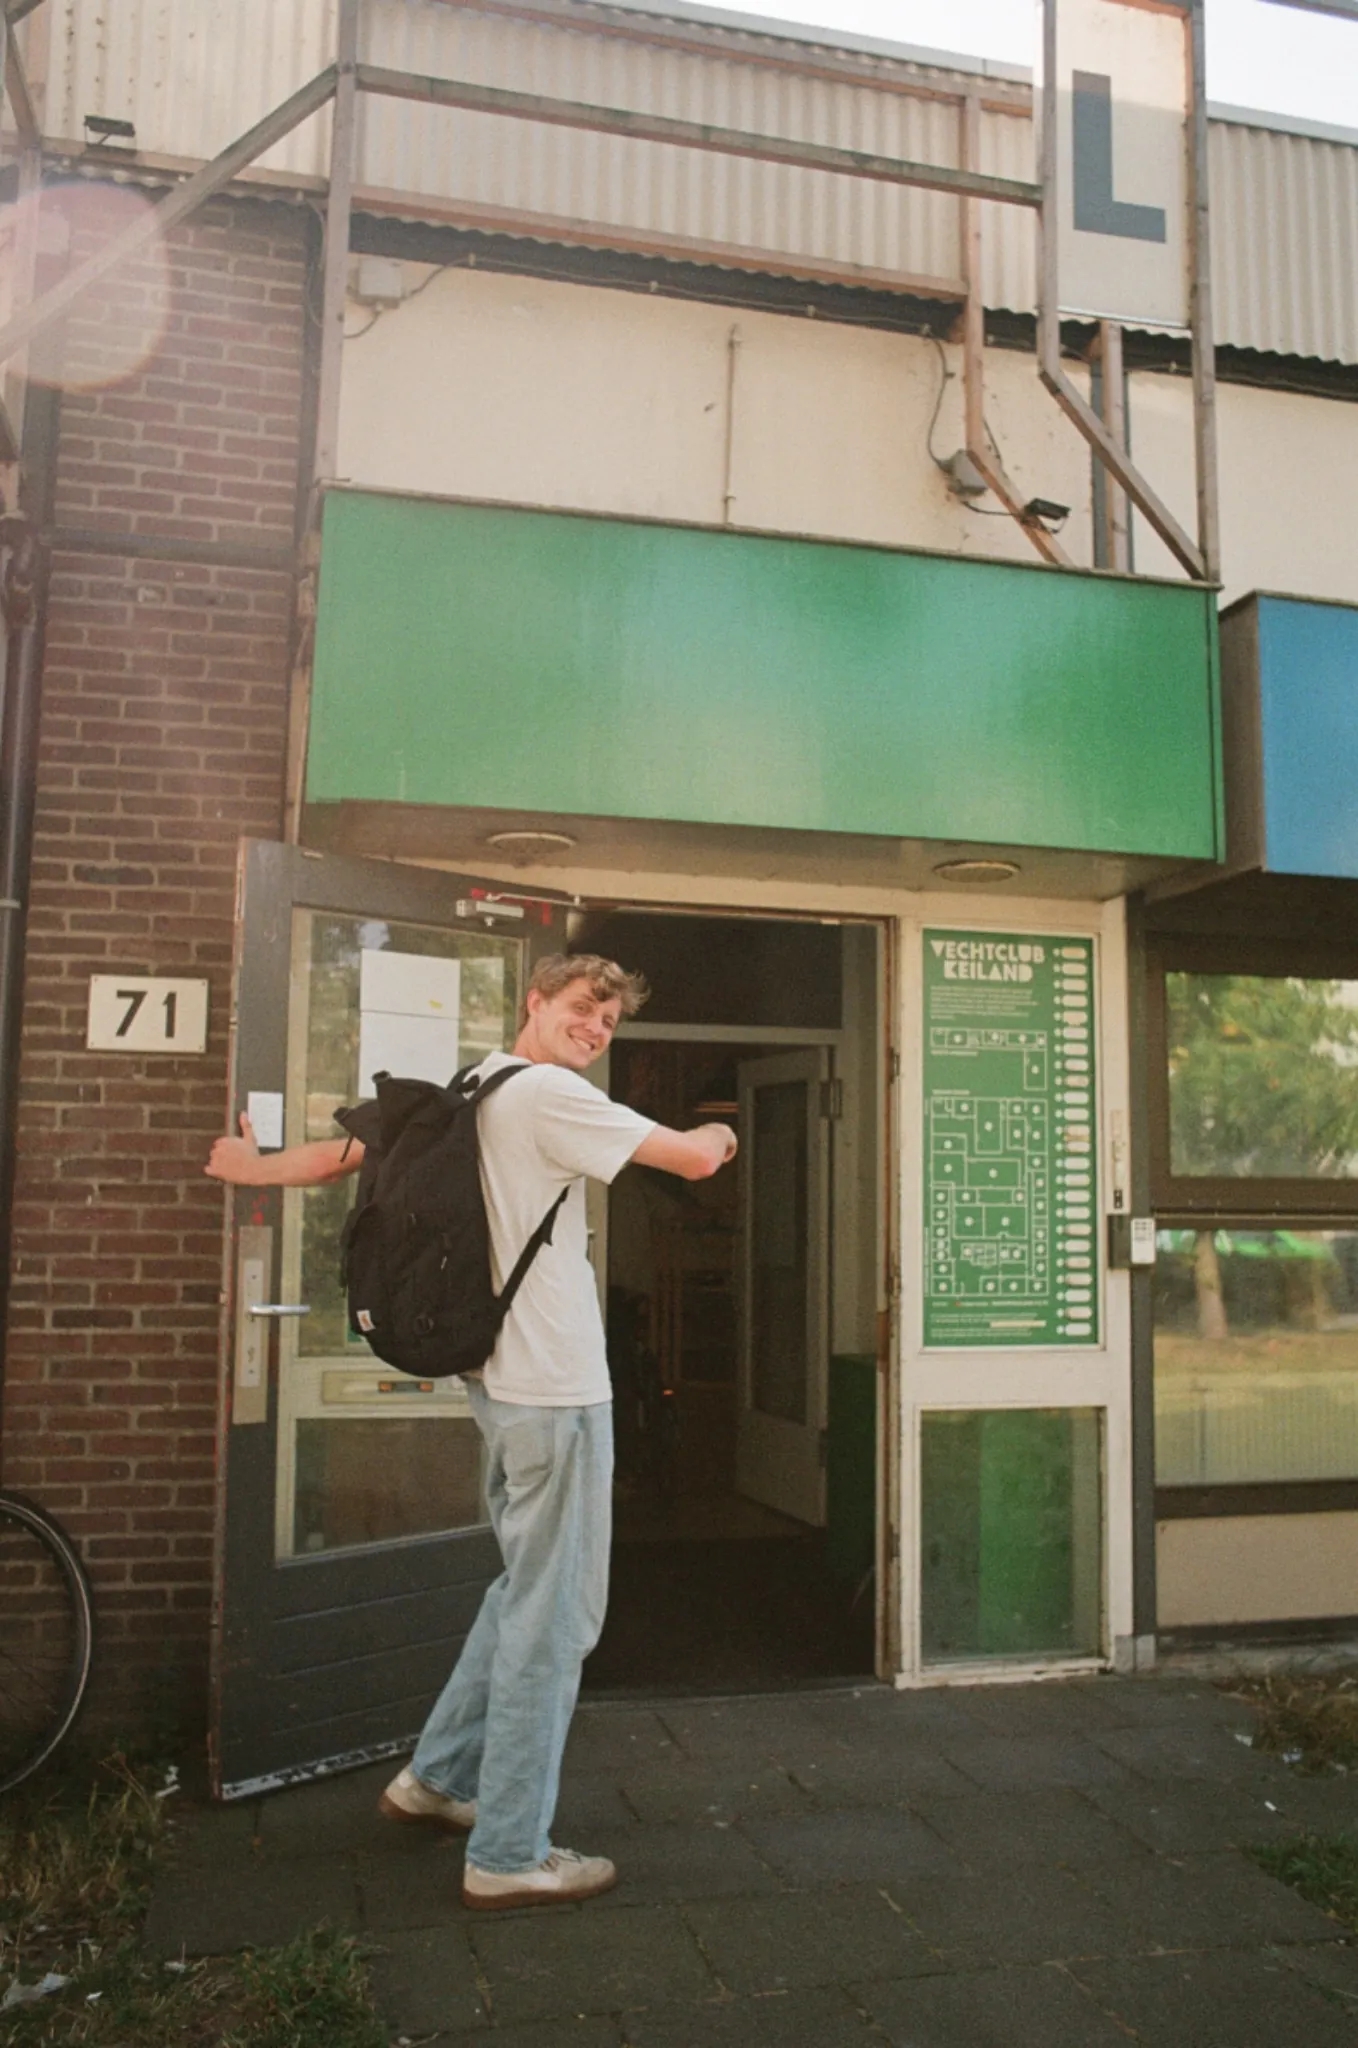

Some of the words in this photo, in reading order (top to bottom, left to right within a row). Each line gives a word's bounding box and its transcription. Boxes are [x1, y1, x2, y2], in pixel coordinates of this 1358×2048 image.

[1072, 69, 1166, 243] L
[930, 940, 1045, 964] VECHTCLUB
[944, 959, 1034, 983] KEILAND
[115, 989, 177, 1039] 71
